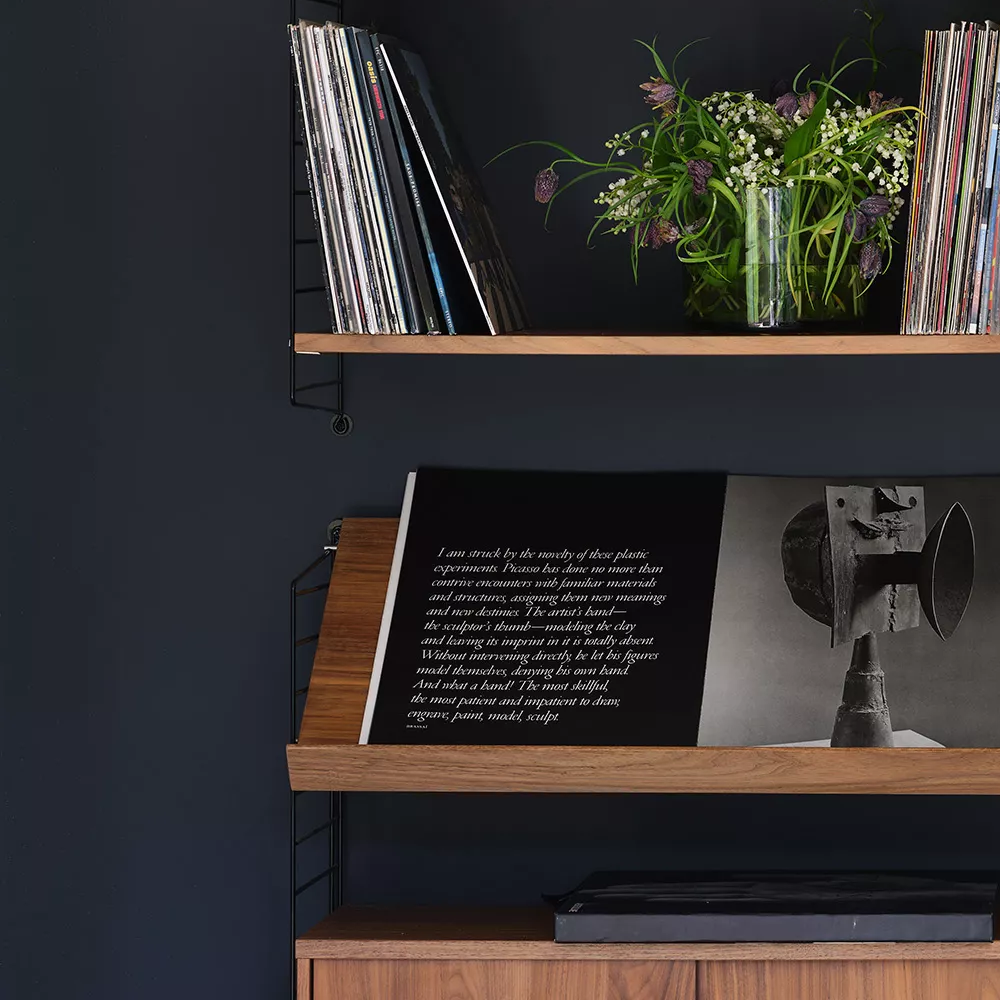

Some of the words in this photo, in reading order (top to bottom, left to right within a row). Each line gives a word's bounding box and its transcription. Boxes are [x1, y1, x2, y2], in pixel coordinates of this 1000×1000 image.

[366, 61, 377, 84] oasis
[438, 547, 444, 556] I
[467, 547, 501, 557] struck
[503, 548, 517, 561] by
[519, 548, 535, 558] the
[538, 549, 574, 562] novelty
[576, 548, 589, 562] of
[588, 548, 613, 558] these
[612, 549, 648, 562] plastic
[502, 563, 540, 572] Picasso
[541, 563, 560, 573] has
[561, 563, 588, 573] done
[638, 563, 663, 573] than
[534, 577, 558, 587] with
[557, 577, 604, 590] familiar
[606, 578, 656, 587] materials
[428, 591, 453, 601] and
[510, 592, 558, 605] assigning
[560, 591, 588, 601] them
[615, 592, 666, 605] meanings
[426, 605, 450, 615] and
[526, 606, 546, 616] The
[423, 619, 440, 630] the
[595, 621, 612, 630] the
[614, 622, 636, 636] clay
[420, 634, 445, 644] and
[446, 634, 484, 649] leaving
[486, 636, 498, 645] its
[501, 636, 544, 649] imprint
[546, 636, 559, 645] in
[561, 636, 570, 645] it
[572, 636, 581, 645] is
[584, 636, 617, 650] totally
[422, 649, 466, 660] Without
[468, 650, 530, 664] intervening
[574, 650, 588, 660] he
[590, 650, 604, 659] let
[605, 650, 621, 660] his
[620, 650, 659, 664] figures
[416, 664, 451, 674] model
[510, 665, 554, 679] denying
[555, 665, 571, 675] his
